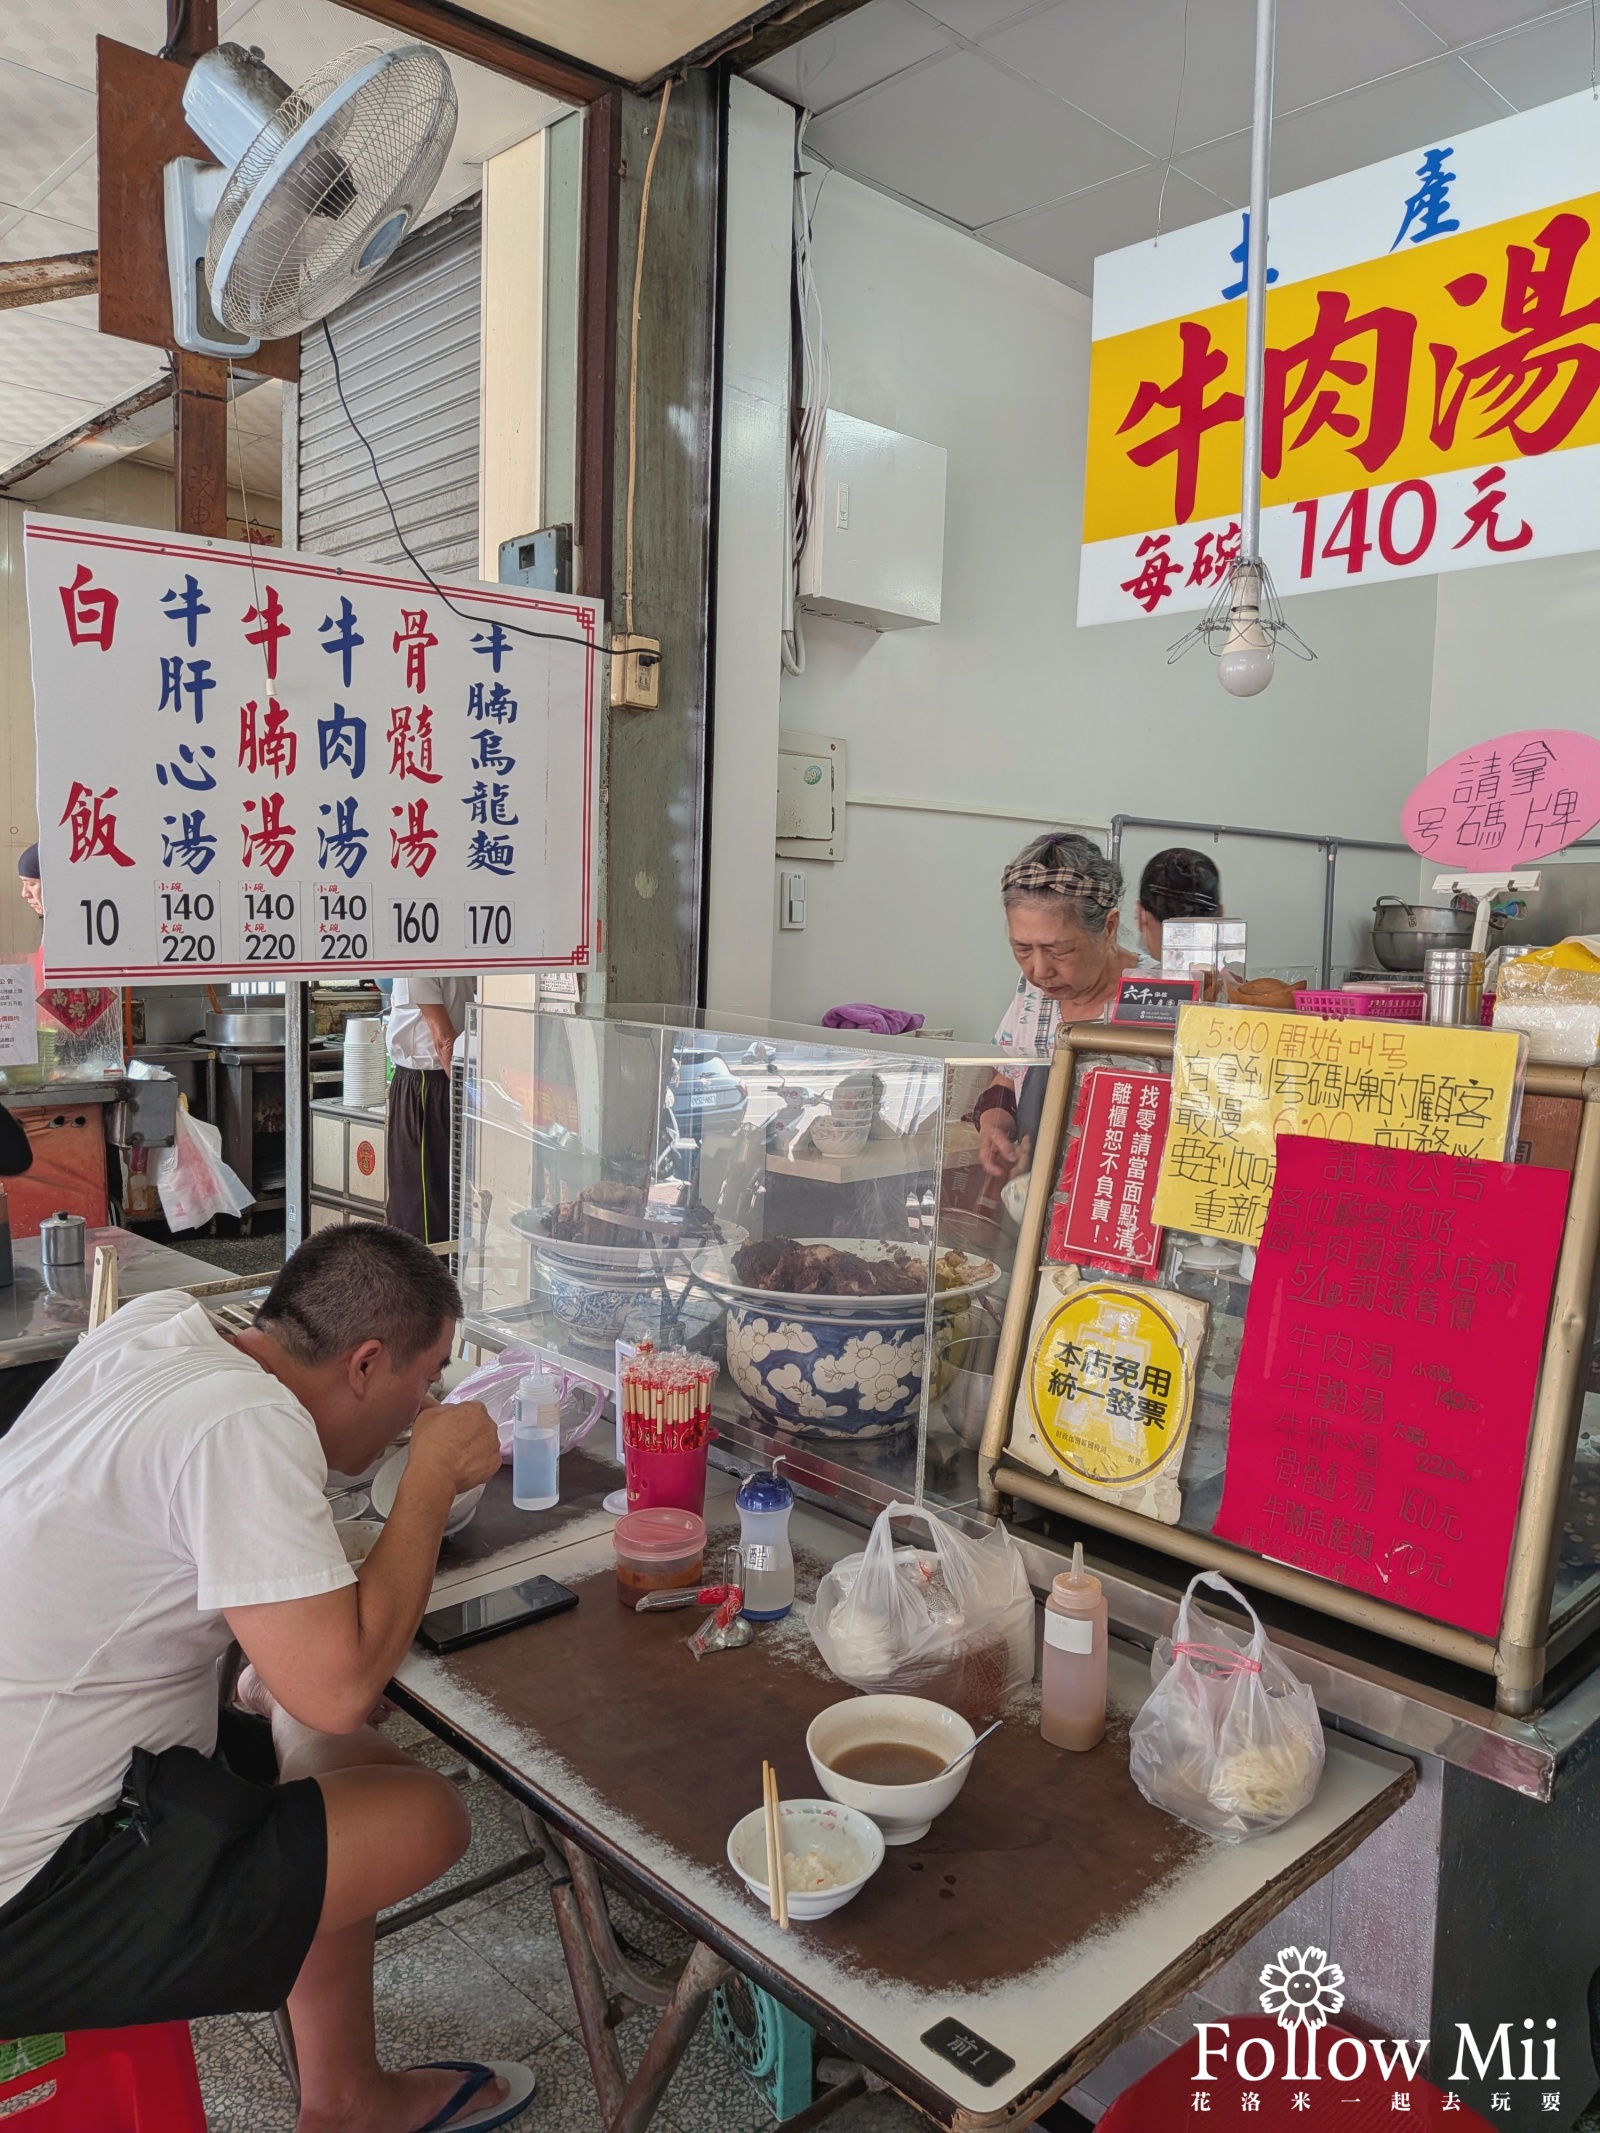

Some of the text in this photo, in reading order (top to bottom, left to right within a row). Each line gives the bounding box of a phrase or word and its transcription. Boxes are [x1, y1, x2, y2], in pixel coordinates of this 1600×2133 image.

[1115, 213, 1600, 526] 牛肉湯
[59, 563, 136, 868] 白飯
[155, 573, 217, 874] 牛肝心湯
[238, 585, 297, 878] 牛腩湯
[317, 595, 369, 878] 牛肉湯
[386, 608, 443, 877] 骨髓湯
[461, 622, 518, 876] 牛腩烏龍麵
[1453, 740, 1557, 803] 請拿
[80, 899, 119, 946] 10
[161, 893, 214, 921] 140
[244, 893, 295, 921] 140
[319, 895, 367, 921] 140
[393, 901, 439, 944] 160
[468, 905, 512, 945] 170
[162, 934, 216, 962] 220
[245, 933, 296, 960] 220
[320, 933, 368, 960] 220
[1054, 1340, 1172, 1398] 本店免用
[1288, 1323, 1394, 1379] 牛肉湯
[1048, 1368, 1168, 1431] 統一發票
[1279, 1364, 1384, 1425] 牛腩湯
[1275, 1408, 1379, 1470] 牛肝心湯
[1399, 1486, 1463, 1542] 160元
[748, 1545, 768, 1570] 醋
